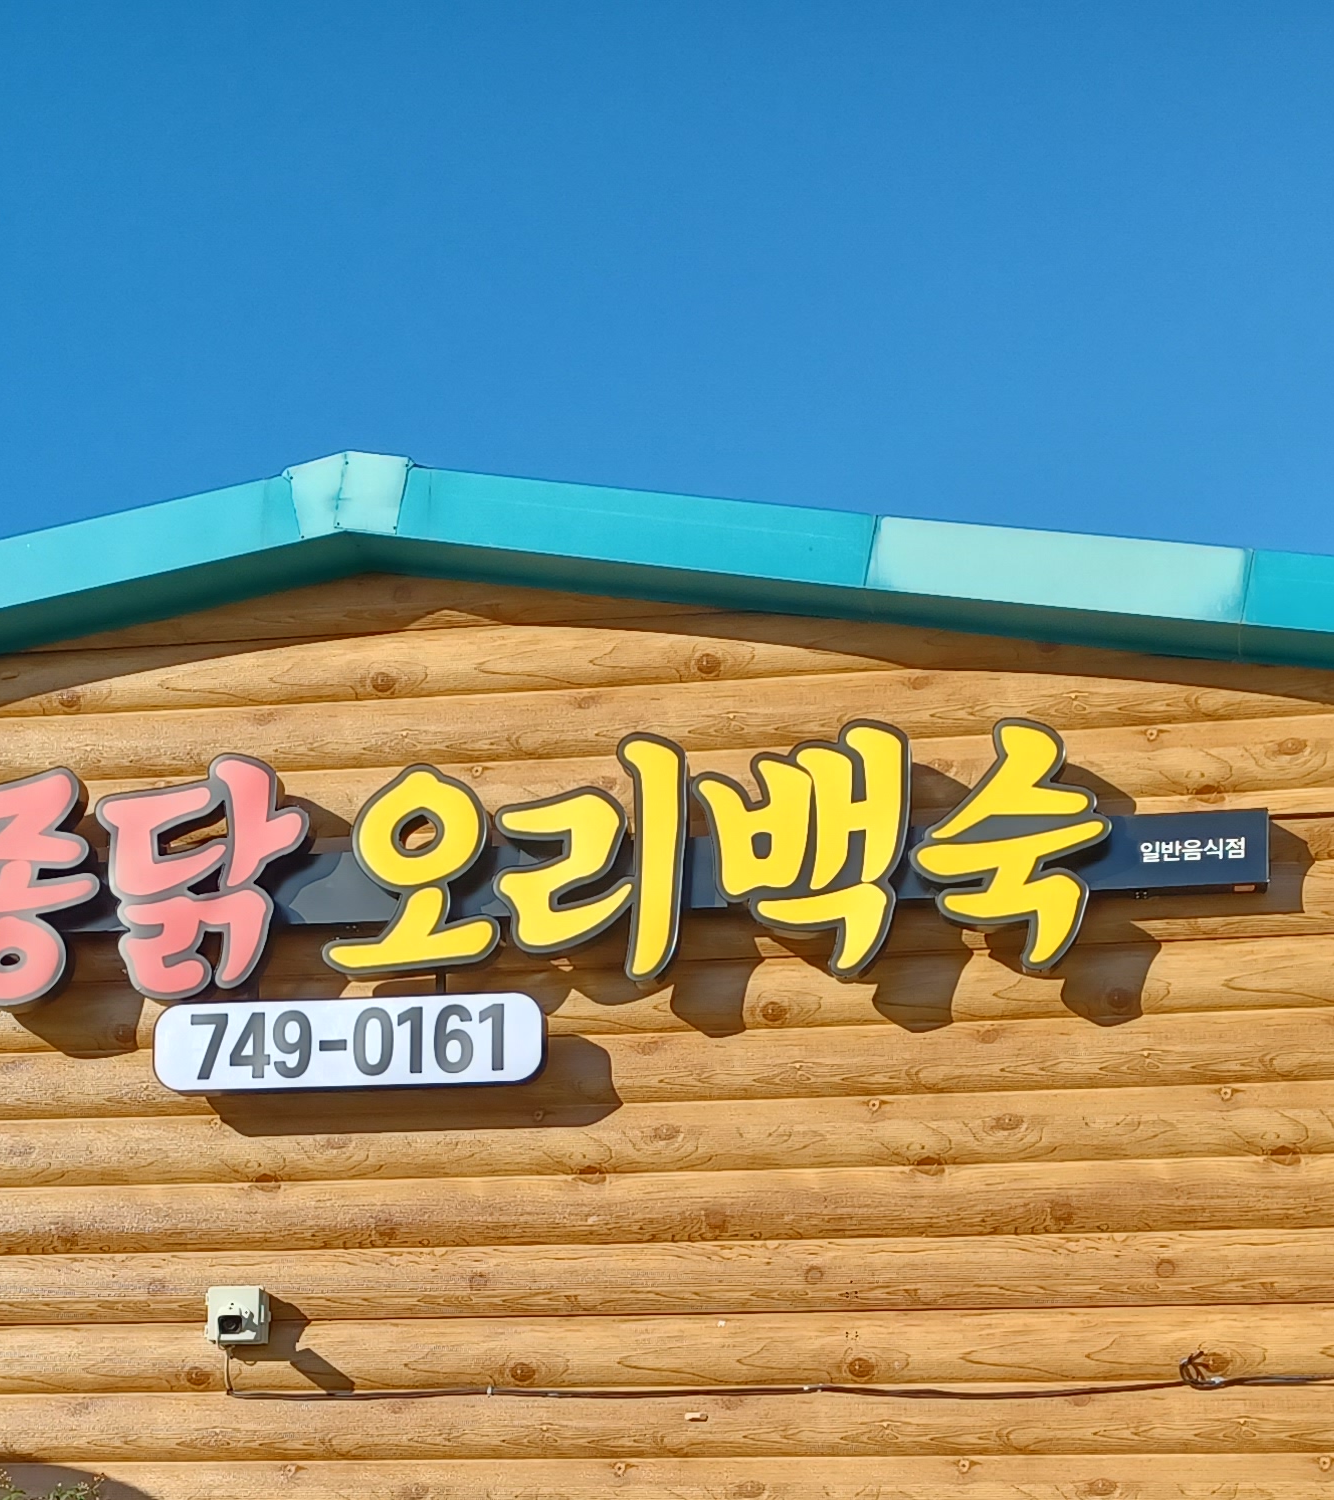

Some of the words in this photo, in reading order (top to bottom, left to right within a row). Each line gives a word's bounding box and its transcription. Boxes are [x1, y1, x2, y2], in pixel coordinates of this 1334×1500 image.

[321, 718, 1111, 980] 오리백숙
[1140, 837, 1246, 863] 일반음식점
[190, 1003, 505, 1080] 749-0161
